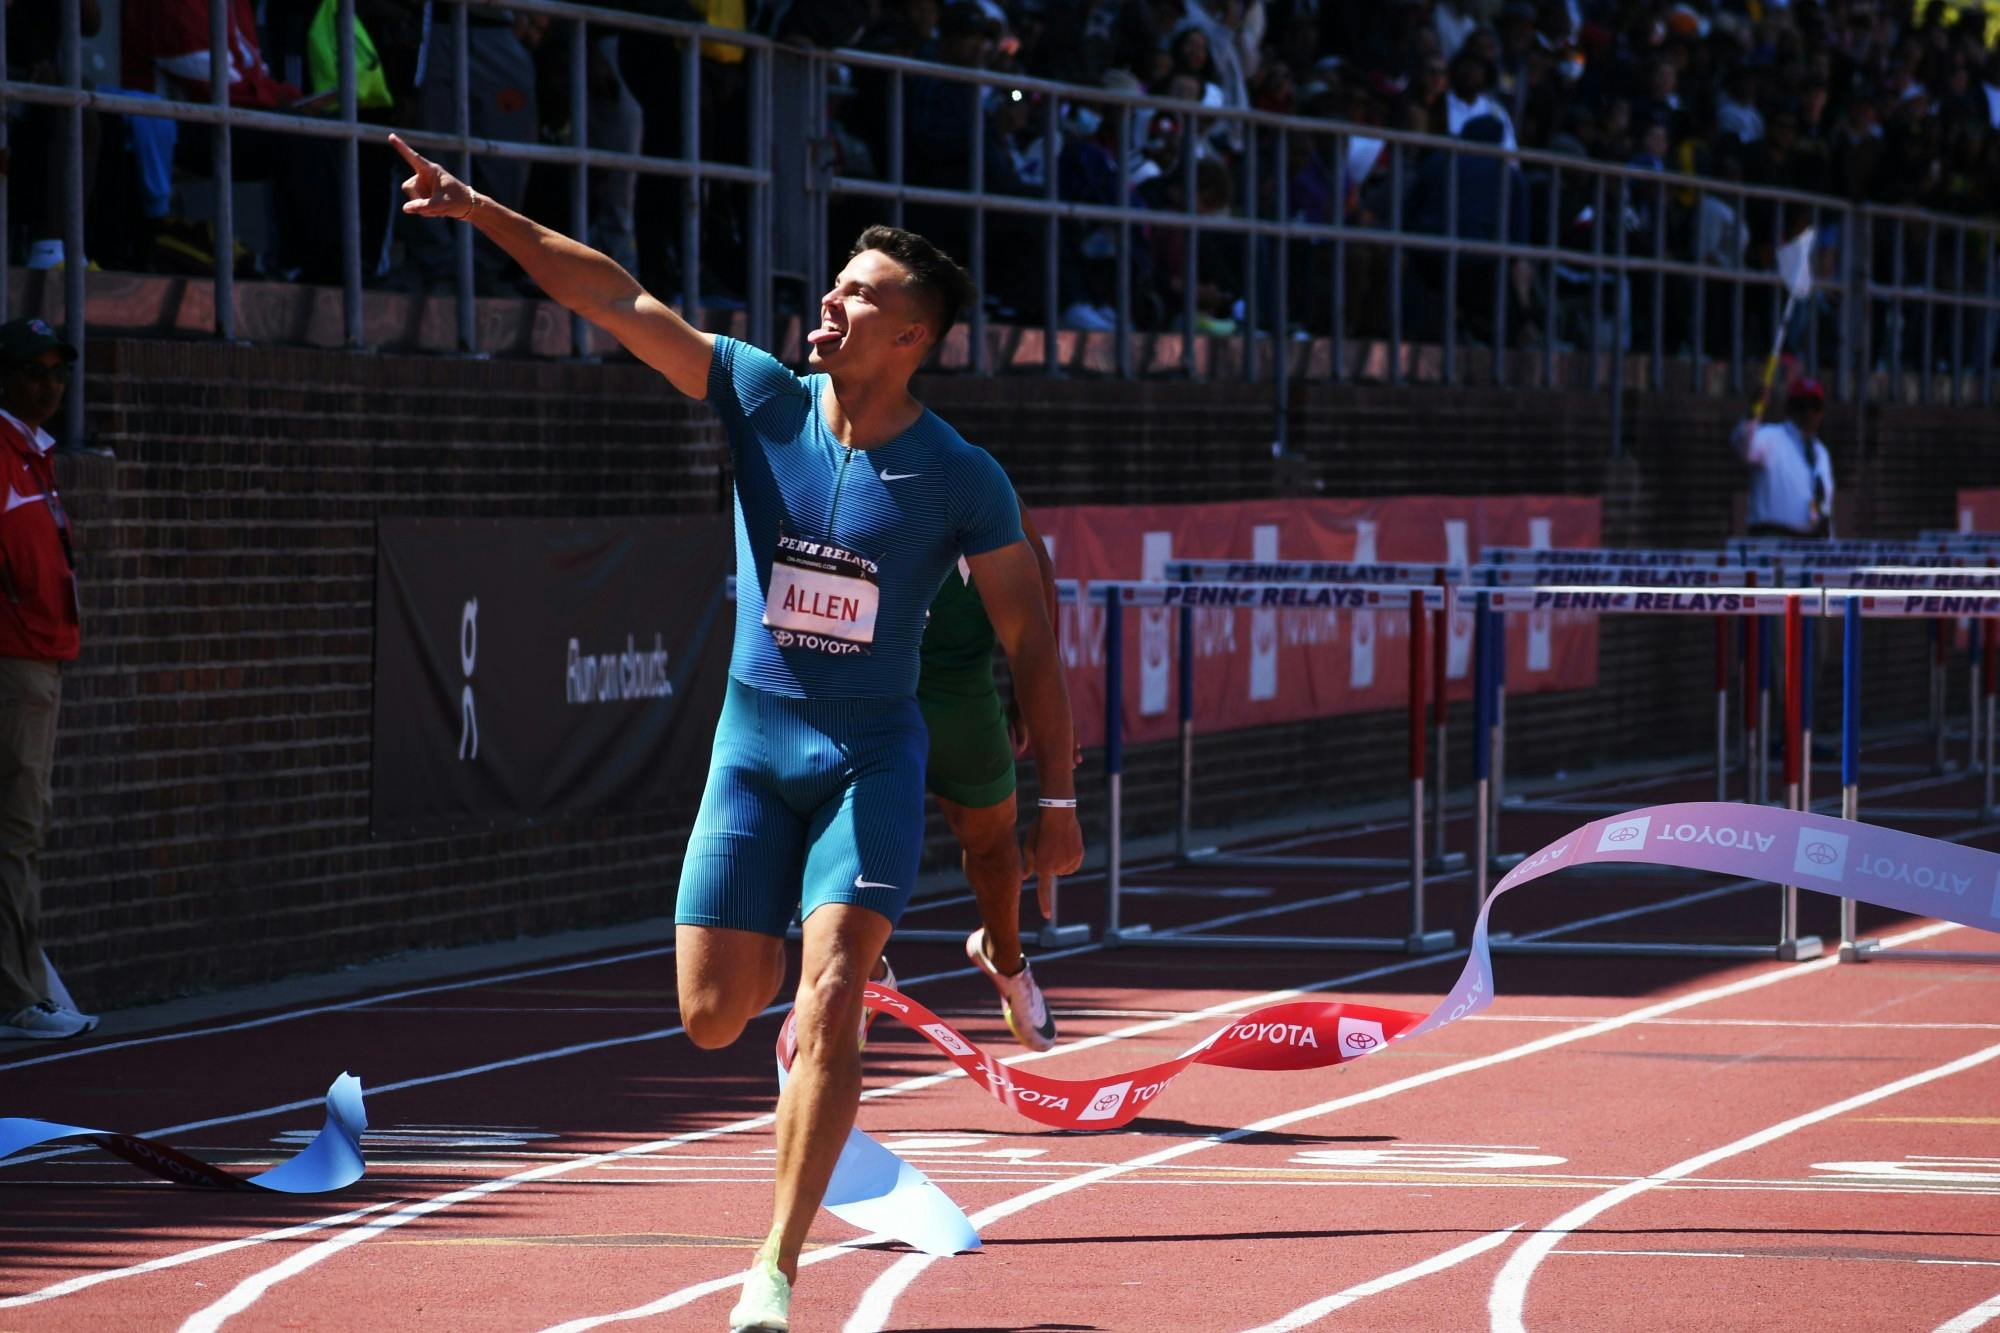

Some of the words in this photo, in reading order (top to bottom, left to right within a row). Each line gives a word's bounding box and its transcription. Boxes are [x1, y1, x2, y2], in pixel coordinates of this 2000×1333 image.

[778, 536, 821, 555] PENN
[820, 545, 878, 574] RELAYS
[1226, 564, 1292, 581] PENN
[1308, 565, 1397, 582] RELAYS
[1933, 574, 2000, 588] RELA
[782, 583, 859, 622] ALLEN
[1163, 586, 1241, 606] PENN
[1260, 587, 1366, 608] RELAYS
[1533, 591, 1611, 609] PENN
[1633, 592, 1741, 611] RELAYS
[1904, 595, 1984, 613] PENN
[797, 634, 860, 654] TOYOTA
[864, 990, 910, 1014] OTA
[1229, 1023, 1318, 1048] TOYOTA
[975, 1061, 1070, 1111] TOYOTA
[1132, 1071, 1180, 1104] TOY
